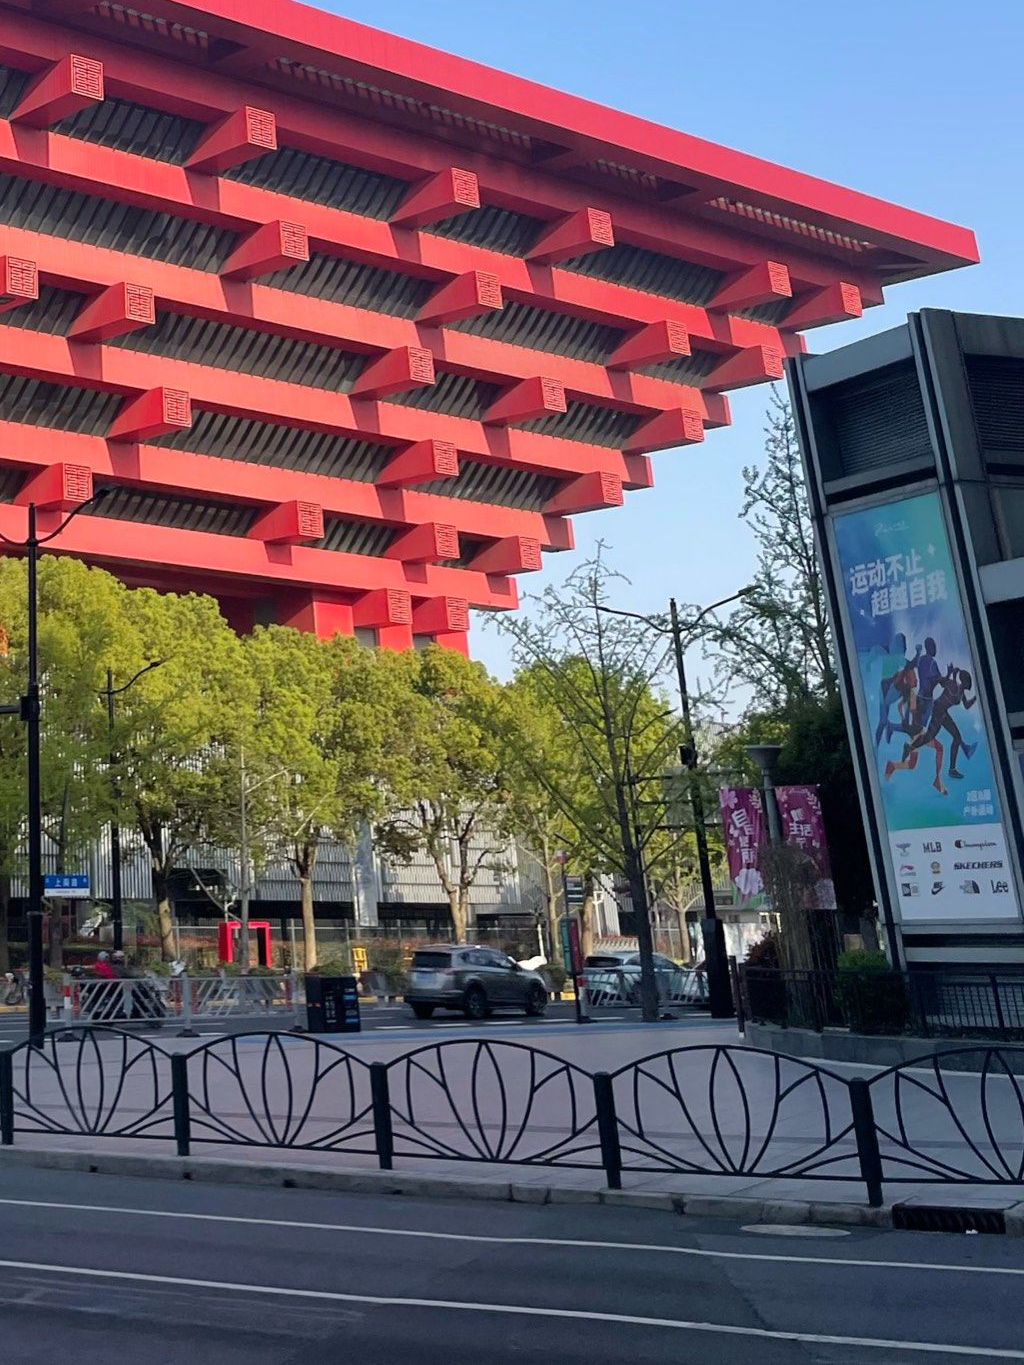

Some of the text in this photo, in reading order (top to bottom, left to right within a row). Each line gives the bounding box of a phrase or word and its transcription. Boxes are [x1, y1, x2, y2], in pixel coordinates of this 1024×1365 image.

[849, 548, 924, 596] 运动不止
[871, 569, 948, 617] 超越自我
[922, 841, 942, 853] MLB
[954, 860, 1003, 870] SKECHERS
[990, 880, 1009, 894] Lee
